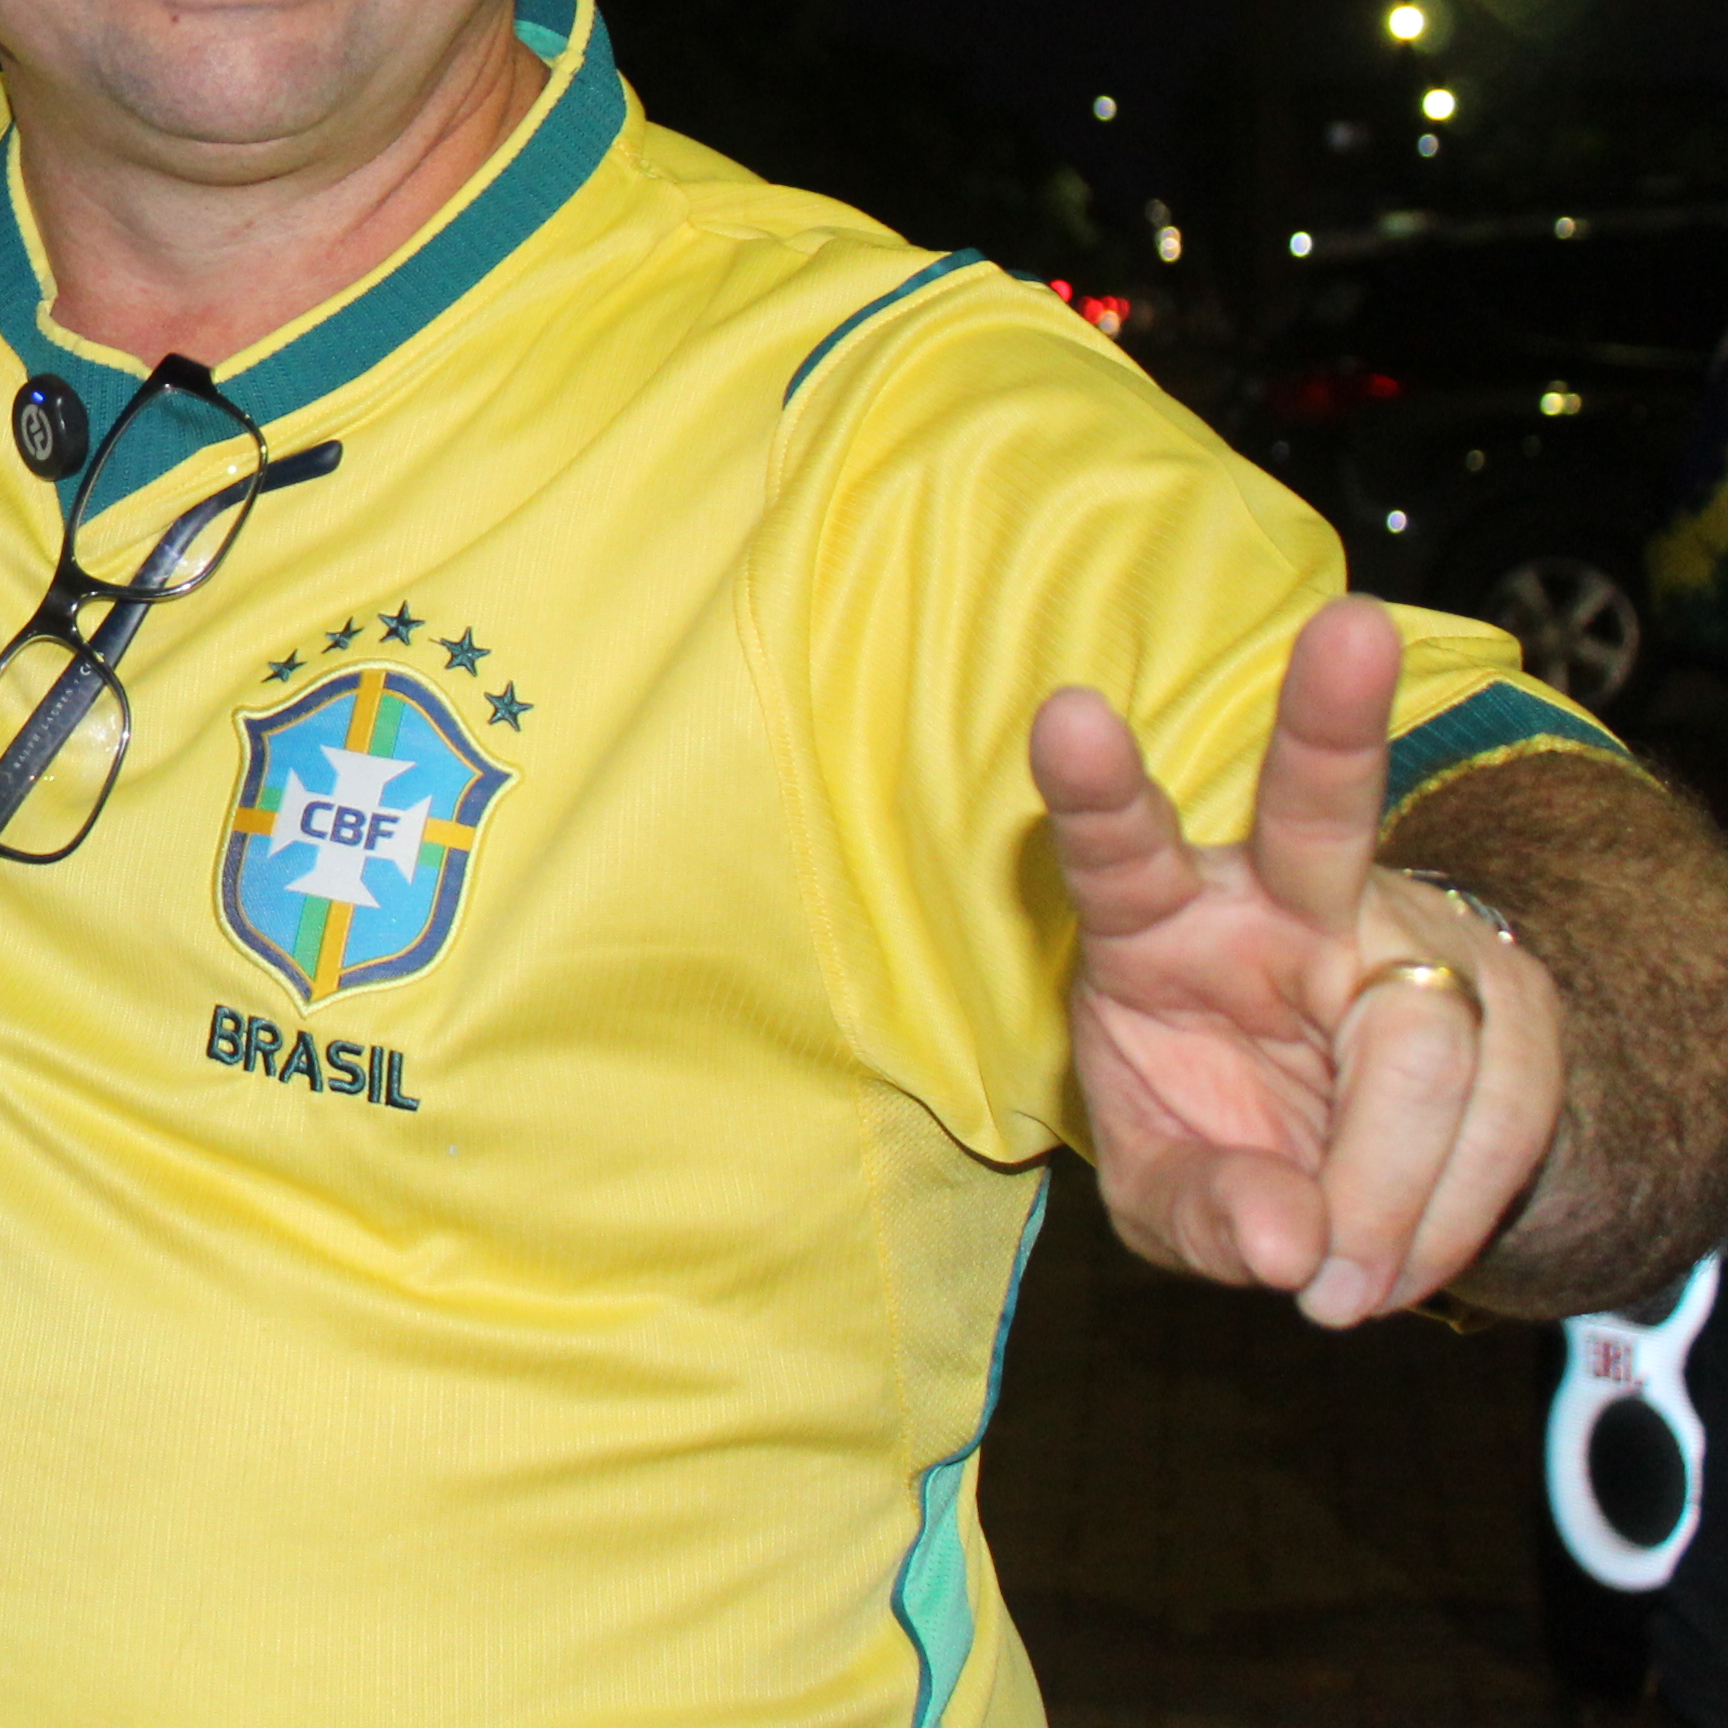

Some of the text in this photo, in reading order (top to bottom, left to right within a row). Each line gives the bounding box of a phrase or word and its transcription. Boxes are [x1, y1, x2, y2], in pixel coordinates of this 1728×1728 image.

[13, 733, 41, 769] RALPH
[300, 800, 401, 851] CBF
[206, 1004, 421, 1112] BRASIL
